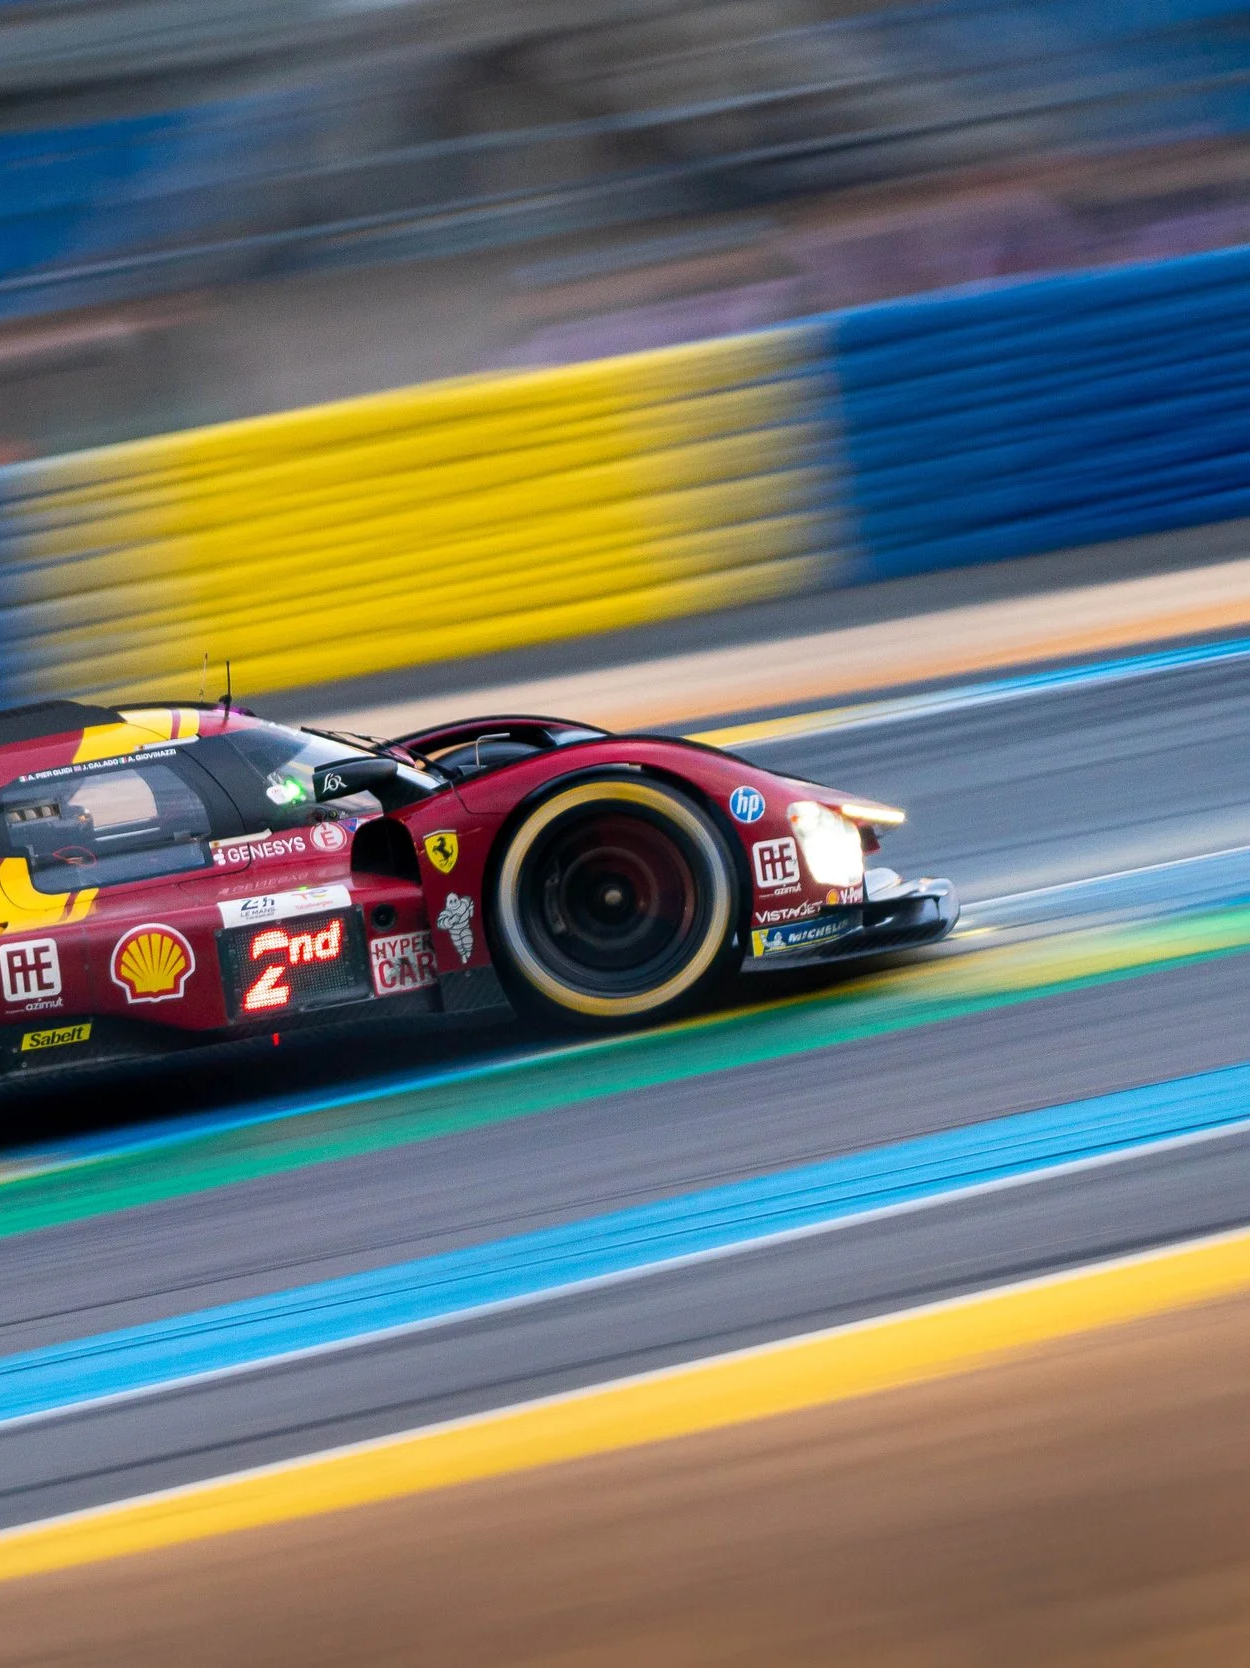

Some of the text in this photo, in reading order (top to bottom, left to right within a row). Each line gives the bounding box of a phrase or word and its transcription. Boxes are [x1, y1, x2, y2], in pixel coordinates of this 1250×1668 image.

[36, 770, 52, 780] PIER
[53, 766, 73, 777] GUIDI
[89, 759, 119, 770] CALADO
[135, 748, 177, 762] GIOVINAZZI
[736, 787, 760, 823] hp
[227, 836, 306, 863] GENESYS
[375, 934, 433, 960] HYPER
[378, 952, 438, 988] CAR
[25, 997, 64, 1012] azimut
[29, 1026, 84, 1048] Sabelt
